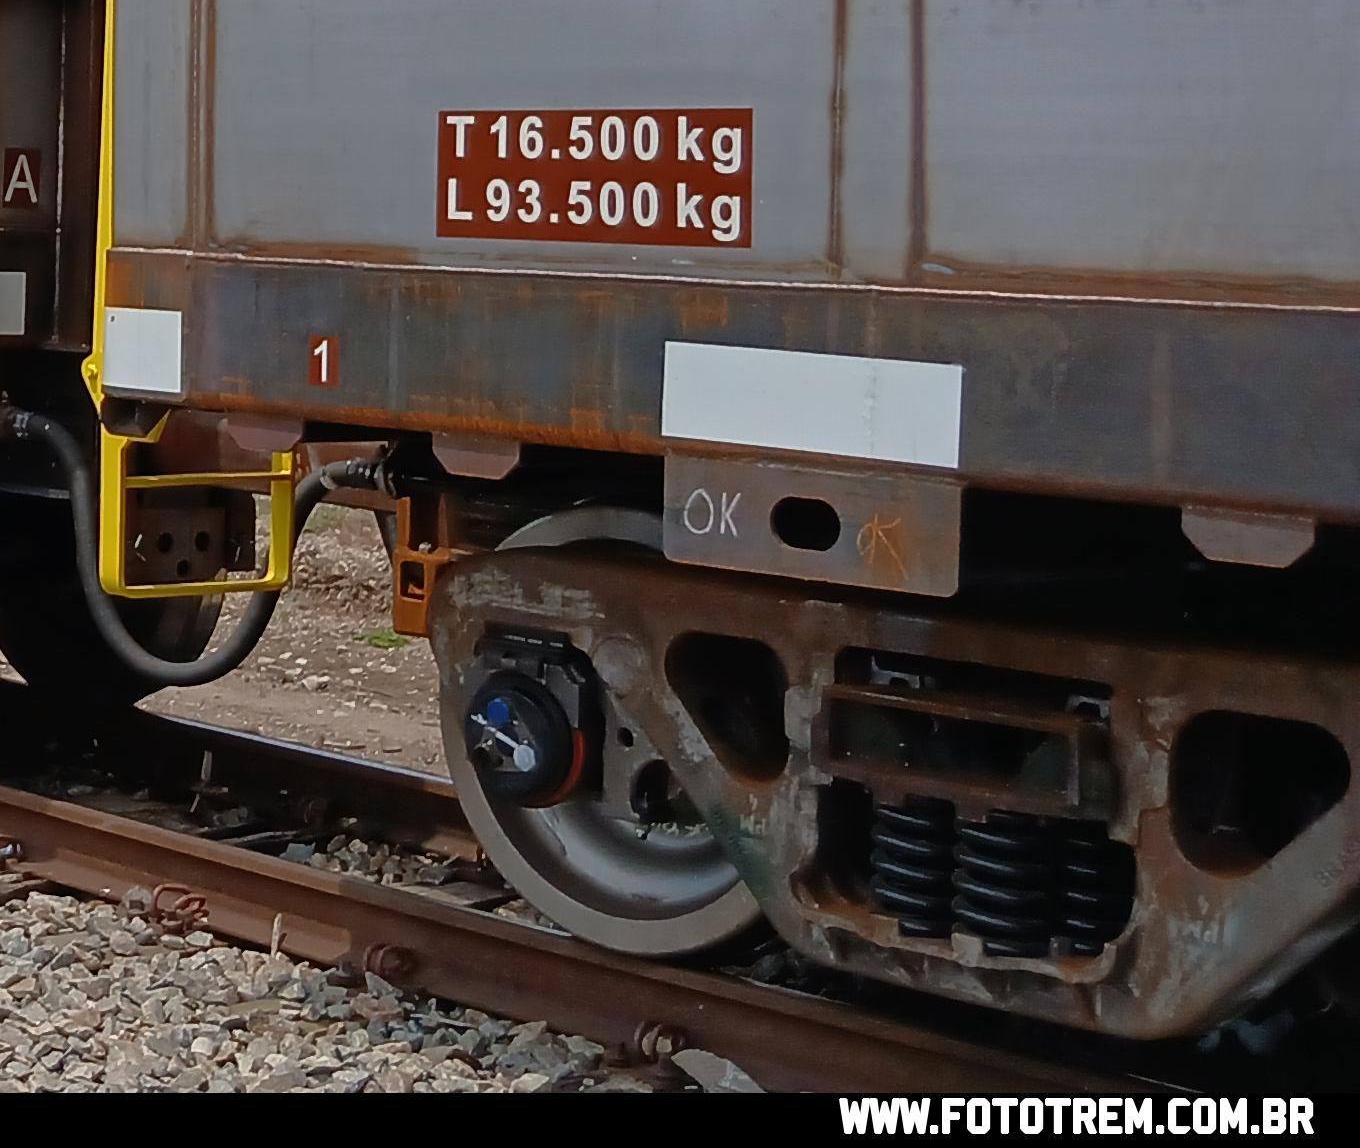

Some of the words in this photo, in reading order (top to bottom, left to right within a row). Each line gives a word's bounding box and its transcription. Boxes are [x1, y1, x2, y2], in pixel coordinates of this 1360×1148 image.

[446, 116, 475, 157] T
[489, 115, 659, 161] 16.500
[677, 115, 742, 174] kg
[4, 154, 38, 204] A
[447, 179, 473, 220] L
[485, 178, 659, 227] 93.500
[676, 182, 741, 242] kg
[313, 340, 328, 383] 1
[684, 488, 742, 537] OK
